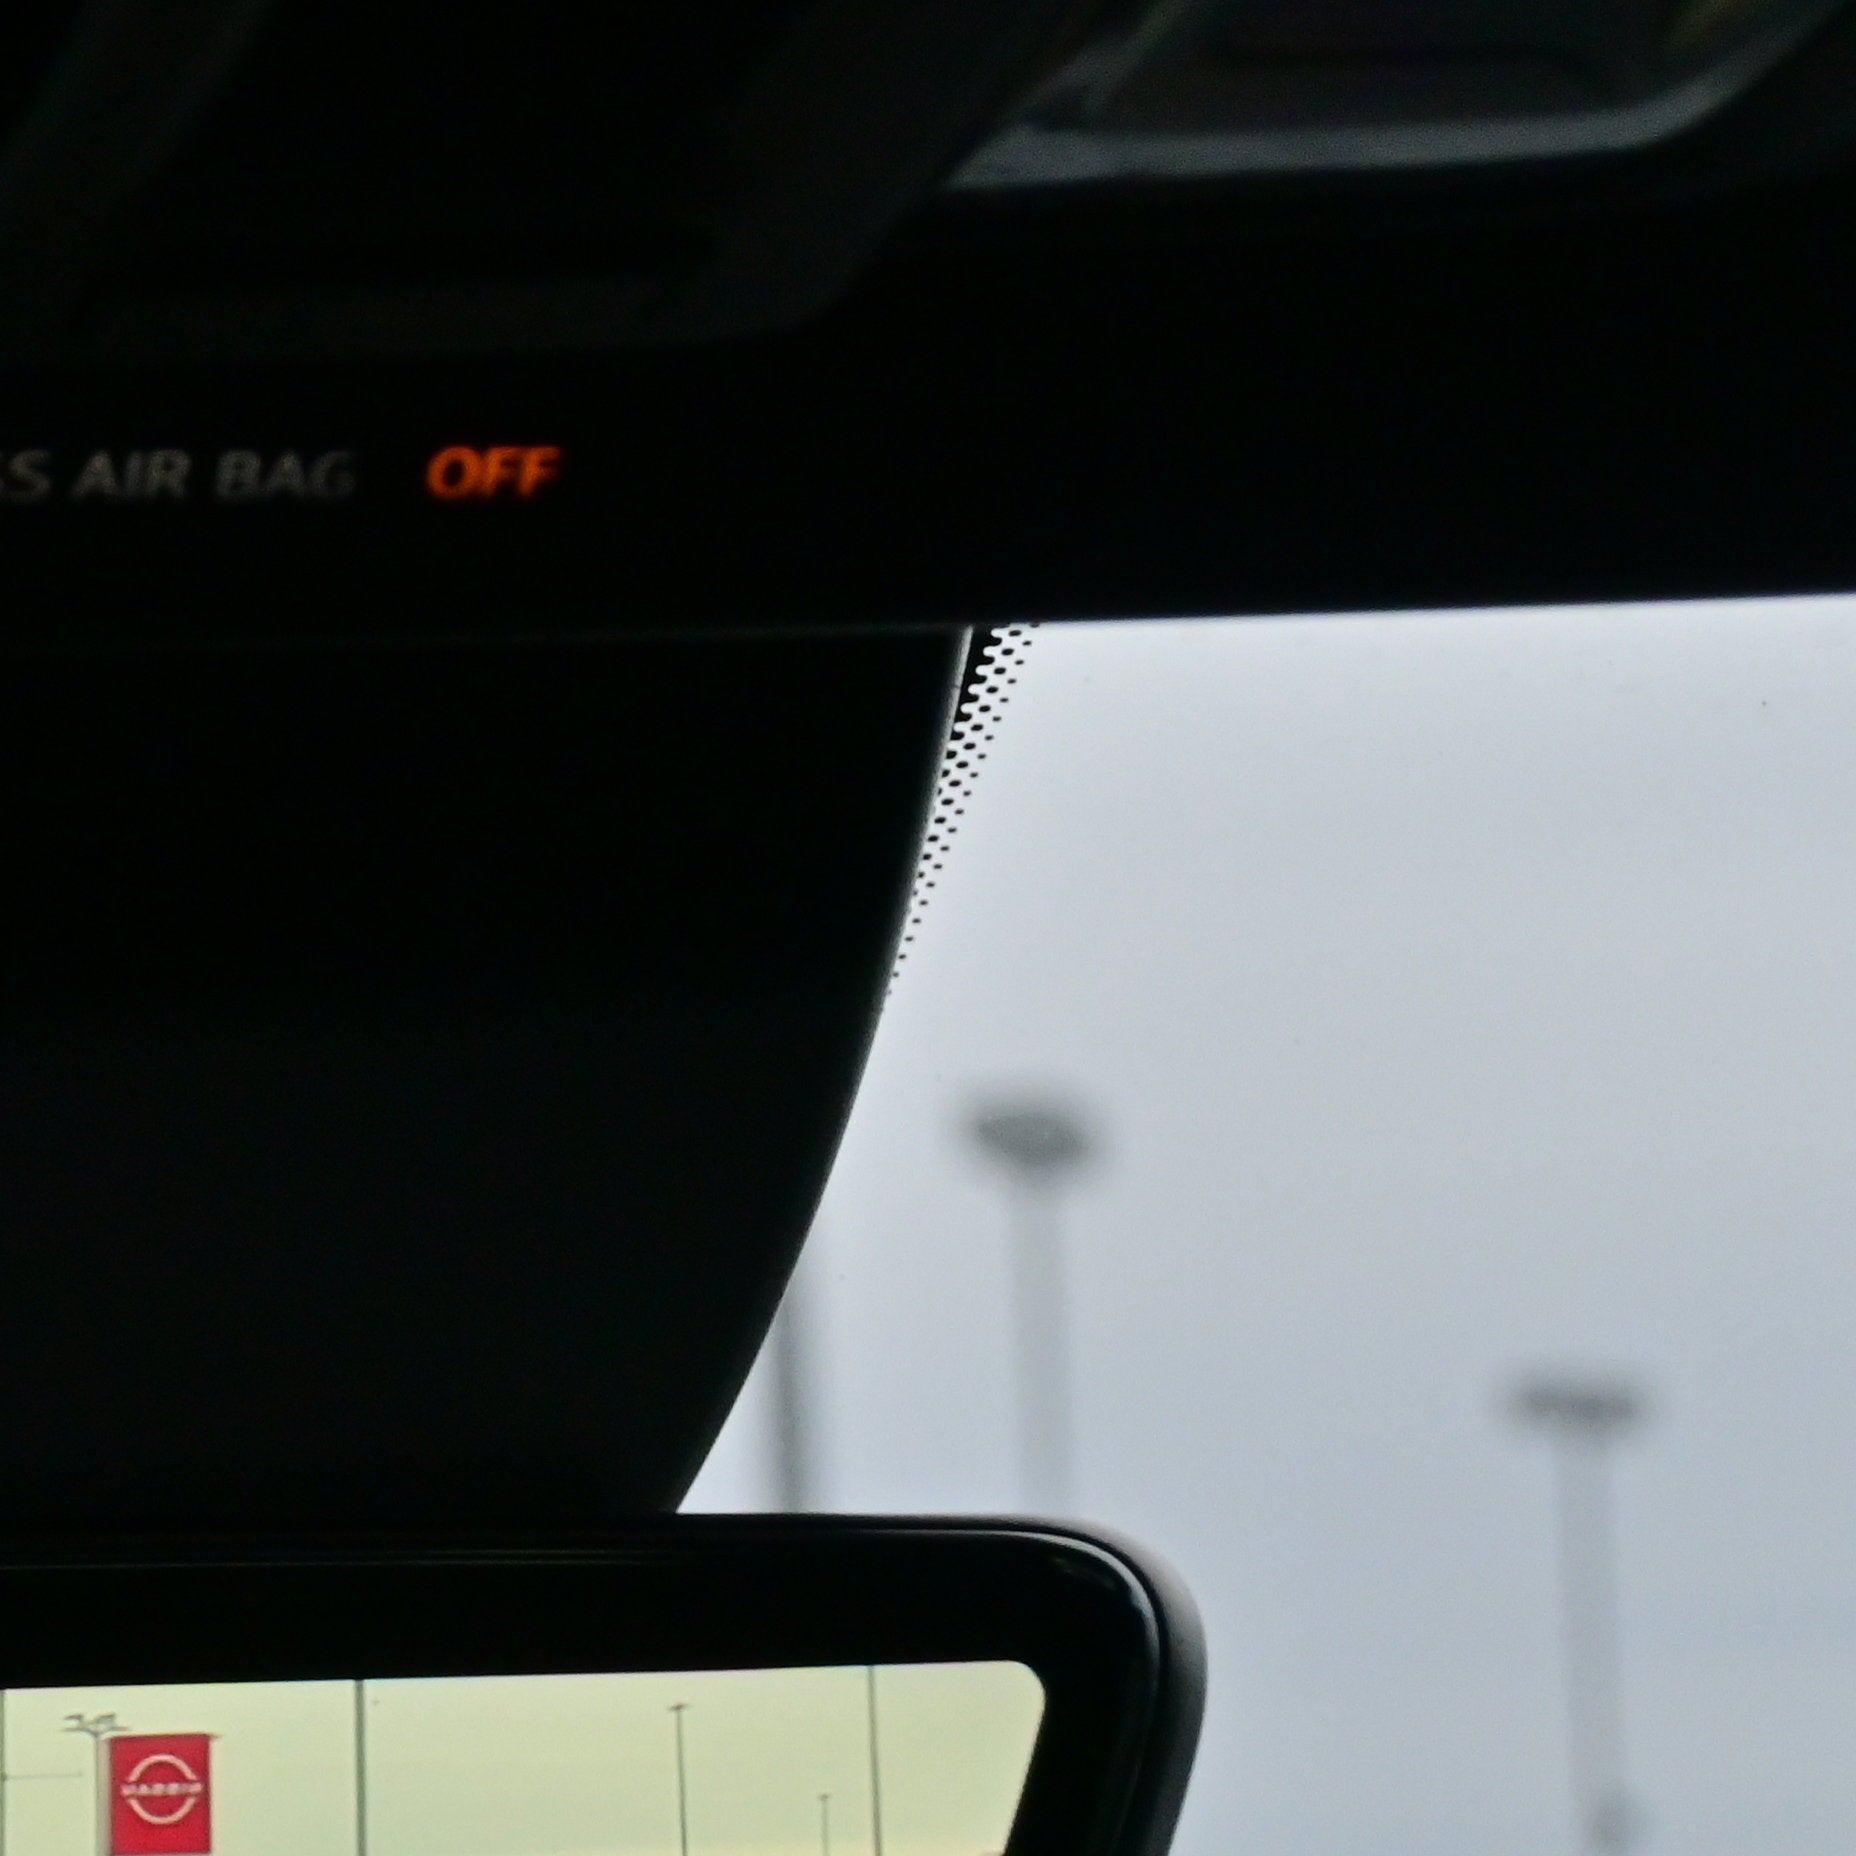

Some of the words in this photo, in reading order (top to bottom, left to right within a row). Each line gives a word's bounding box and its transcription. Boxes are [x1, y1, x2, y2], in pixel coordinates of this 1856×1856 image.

[71, 449, 192, 498] AIR
[215, 449, 356, 498] BAG
[425, 444, 563, 498] OFF
